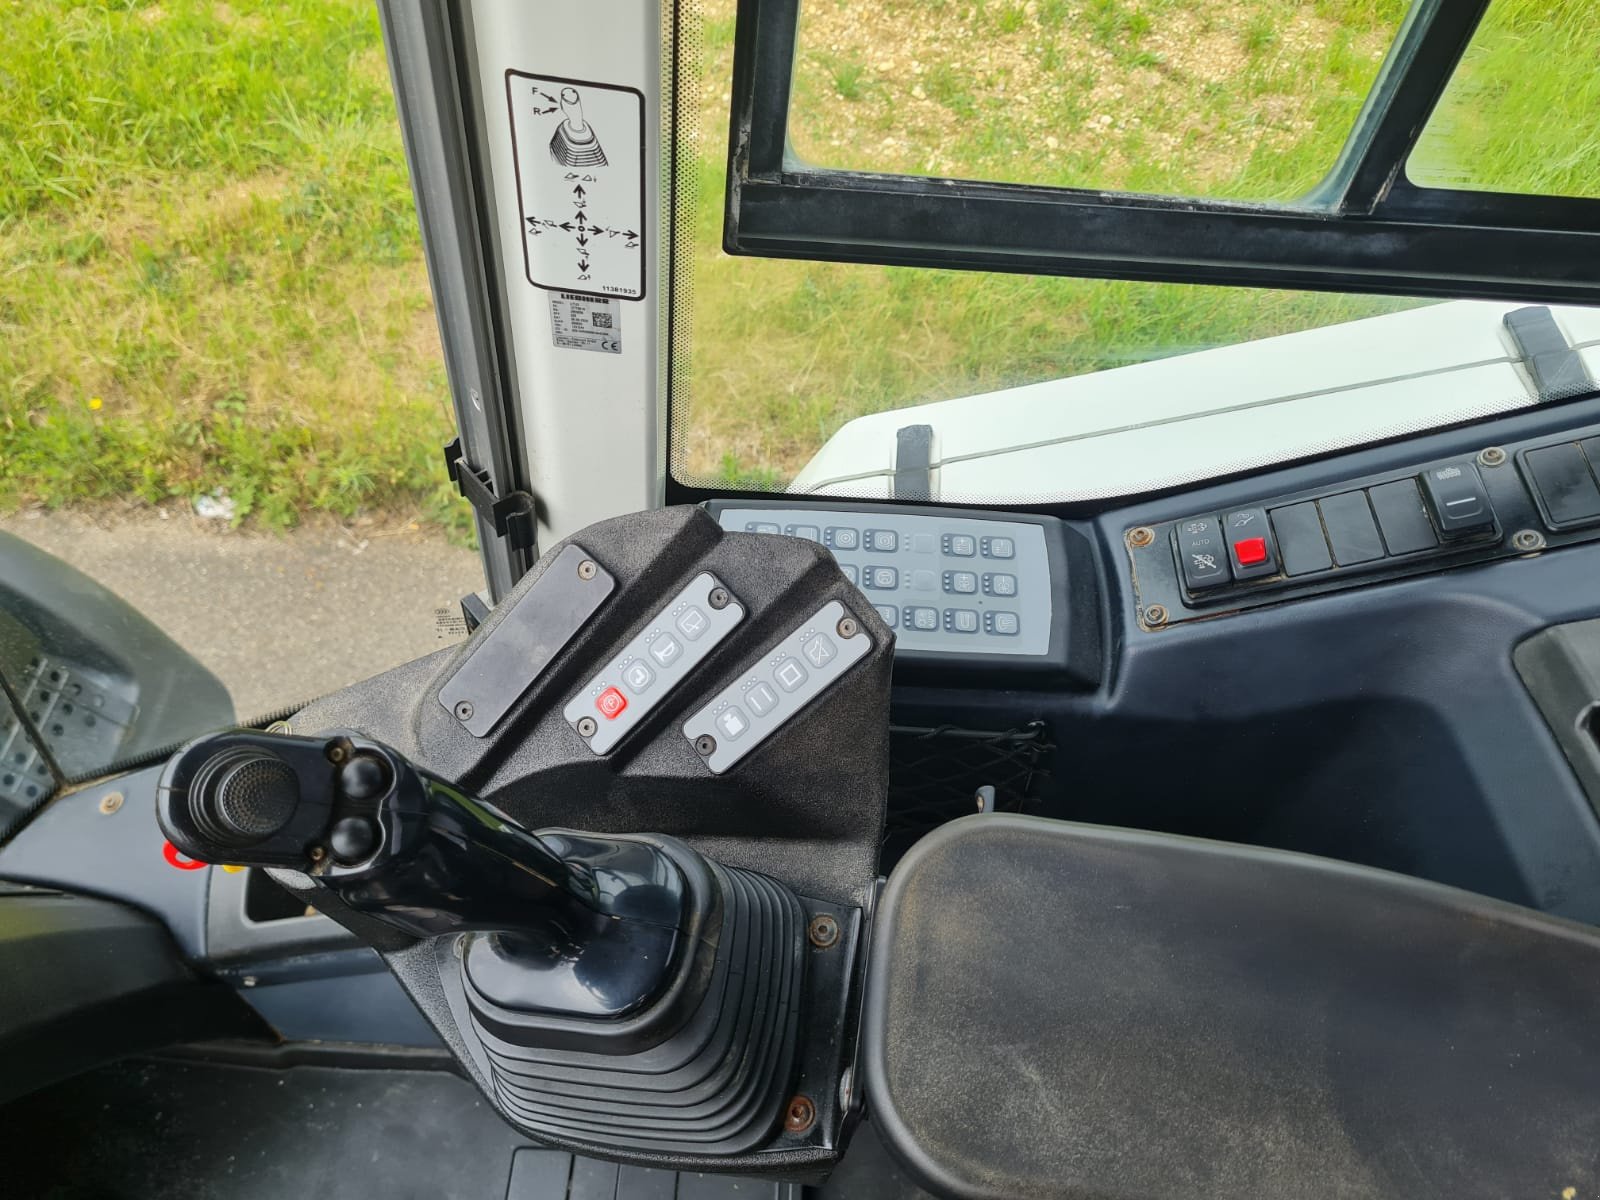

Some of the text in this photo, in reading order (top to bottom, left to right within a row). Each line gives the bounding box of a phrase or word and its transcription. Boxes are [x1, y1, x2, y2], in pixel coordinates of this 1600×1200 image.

[532, 87, 538, 95] F
[533, 107, 541, 116] R
[561, 293, 609, 304] LIEBHERR
